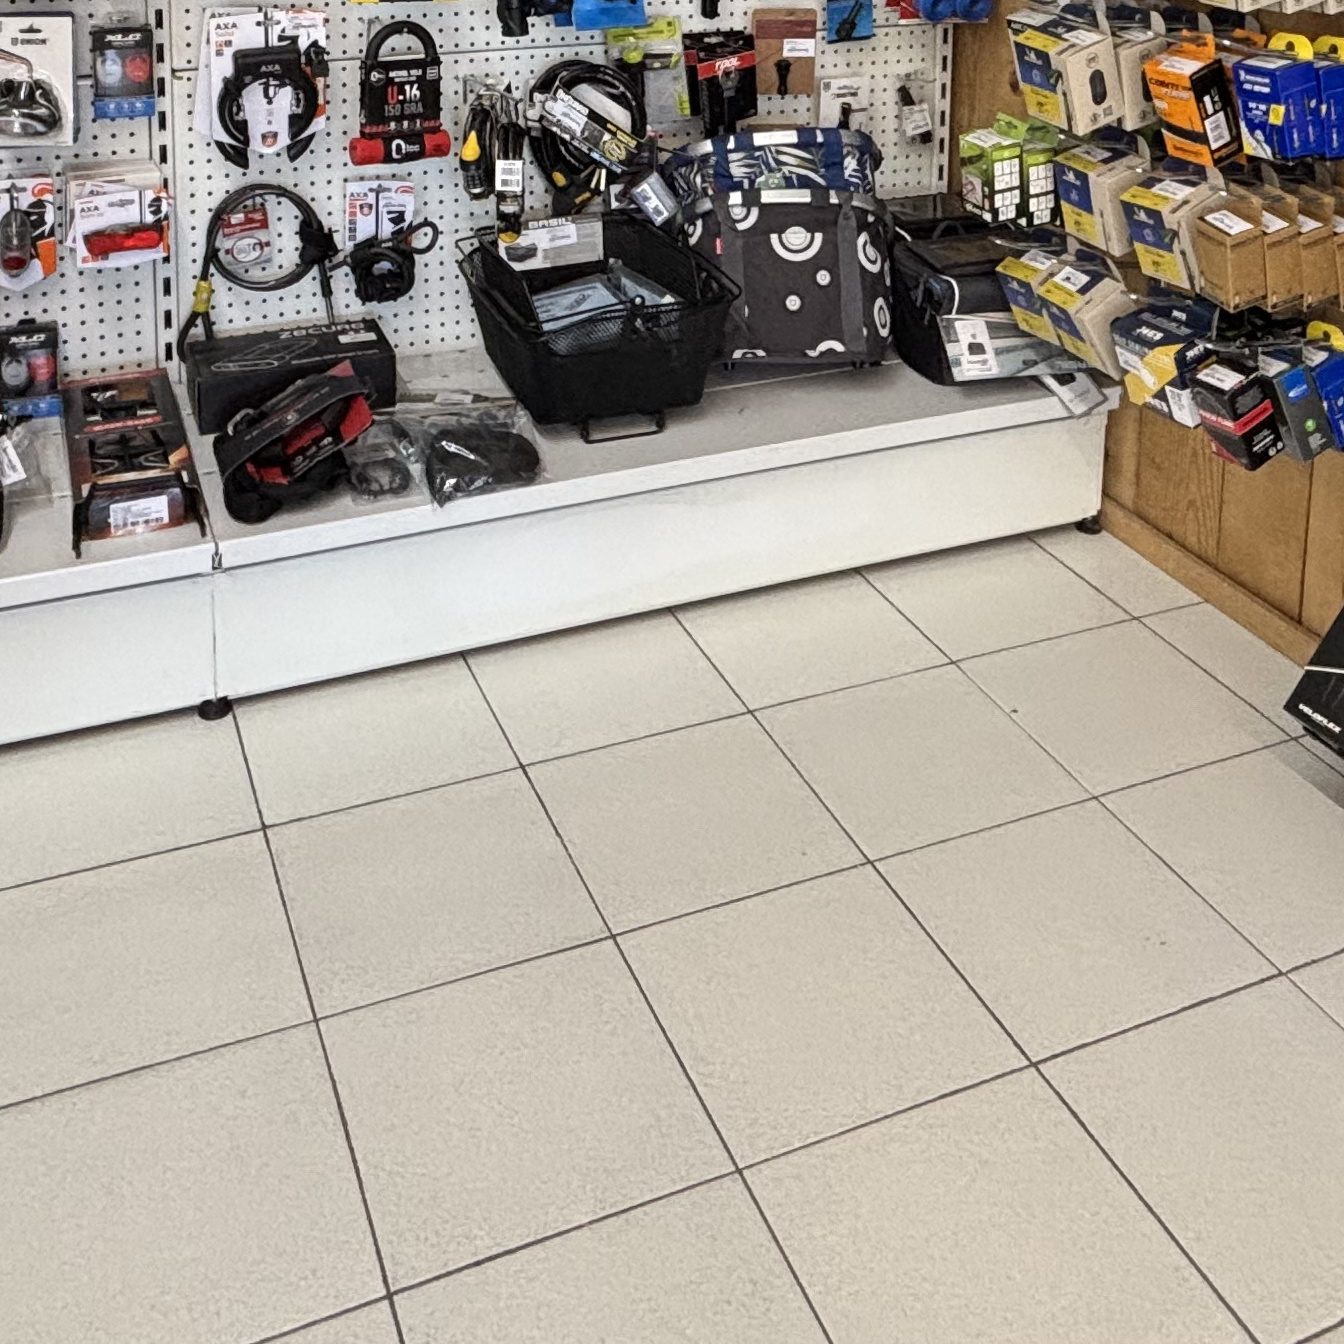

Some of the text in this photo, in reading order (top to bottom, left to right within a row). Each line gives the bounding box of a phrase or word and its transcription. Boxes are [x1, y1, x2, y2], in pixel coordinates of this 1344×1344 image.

[215, 21, 239, 31] AXA
[260, 63, 282, 73] AXA
[79, 205, 100, 214] AXA
[1298, 703, 1342, 734] VELOFLEX
